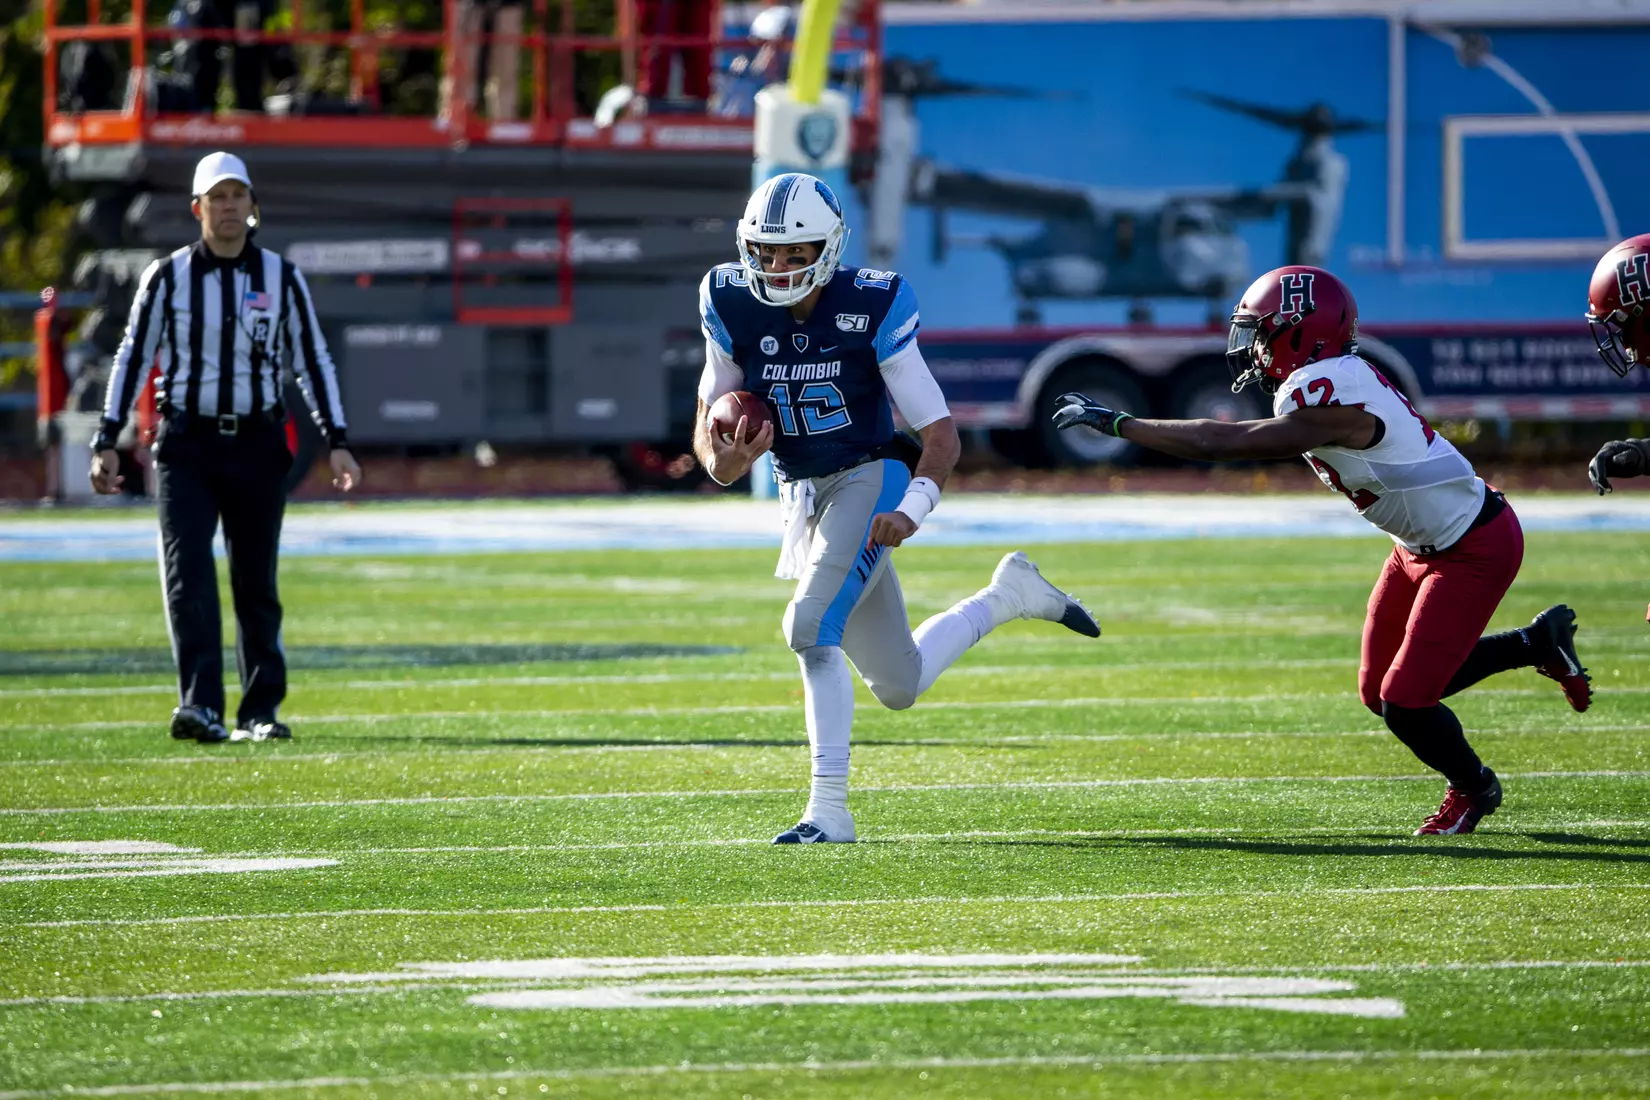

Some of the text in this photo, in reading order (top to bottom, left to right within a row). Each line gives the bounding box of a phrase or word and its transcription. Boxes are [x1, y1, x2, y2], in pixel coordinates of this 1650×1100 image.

[761, 225, 787, 235] LIONS
[854, 268, 897, 290] 12
[1615, 253, 1650, 306] H
[1280, 273, 1316, 314] H
[835, 313, 869, 332] 150
[762, 360, 841, 382] COLUMBIA
[1291, 377, 1341, 410] 12
[768, 382, 852, 436] 12
